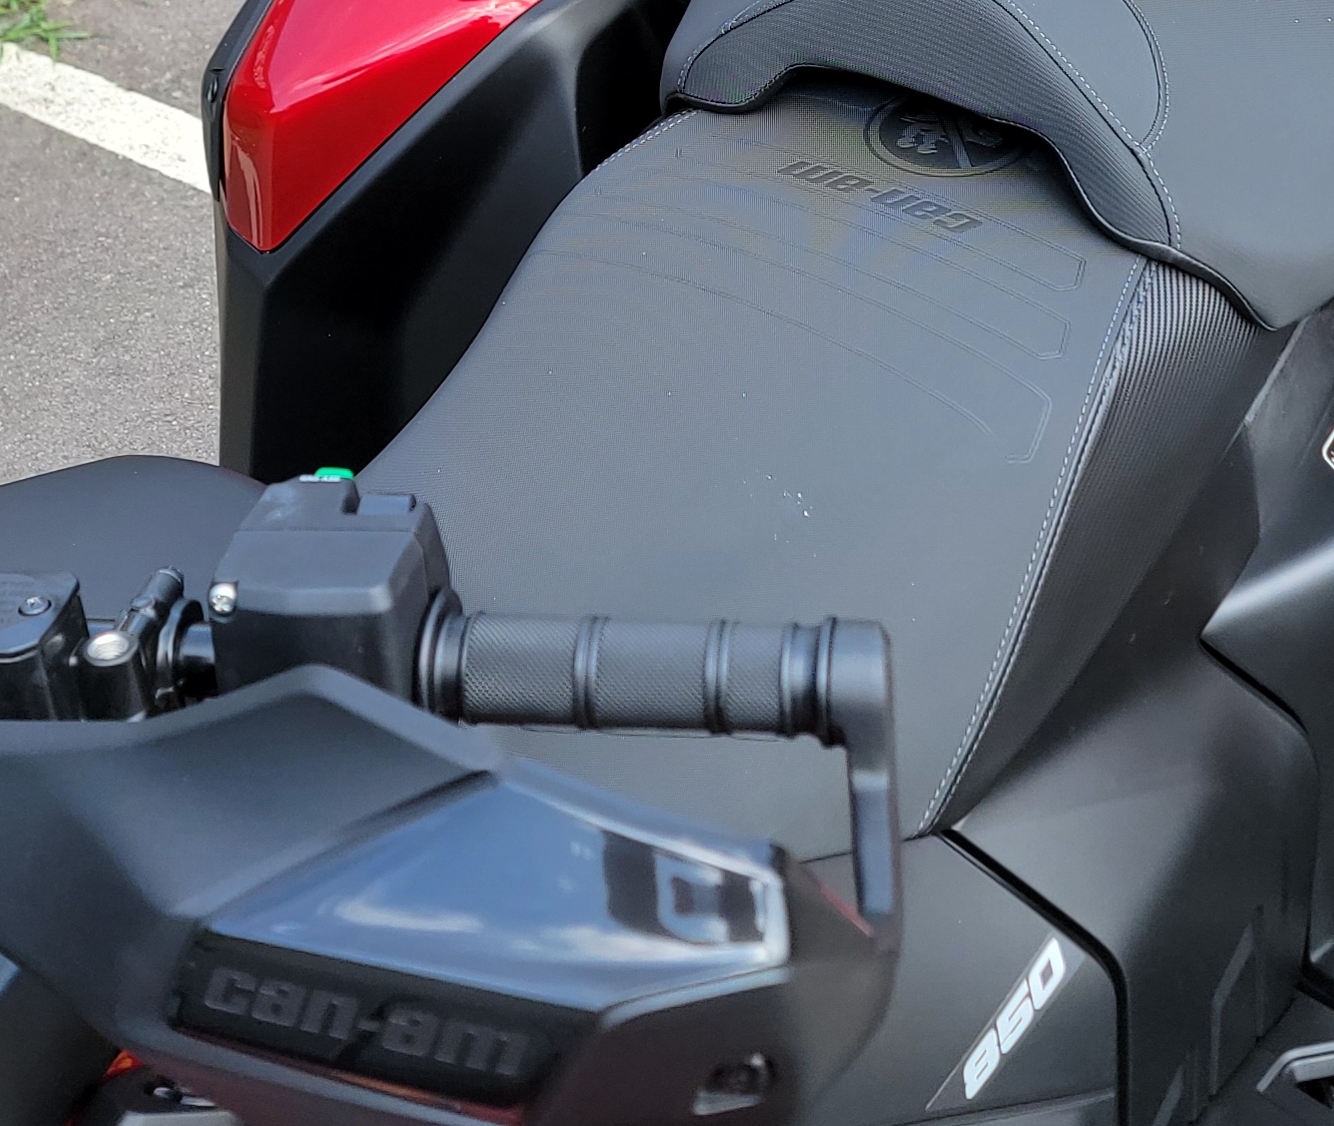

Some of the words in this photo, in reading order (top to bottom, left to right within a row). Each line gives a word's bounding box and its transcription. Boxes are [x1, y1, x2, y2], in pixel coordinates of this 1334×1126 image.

[776, 159, 985, 234] can-am
[203, 966, 533, 1077] can-am
[962, 937, 1065, 1100] 850
